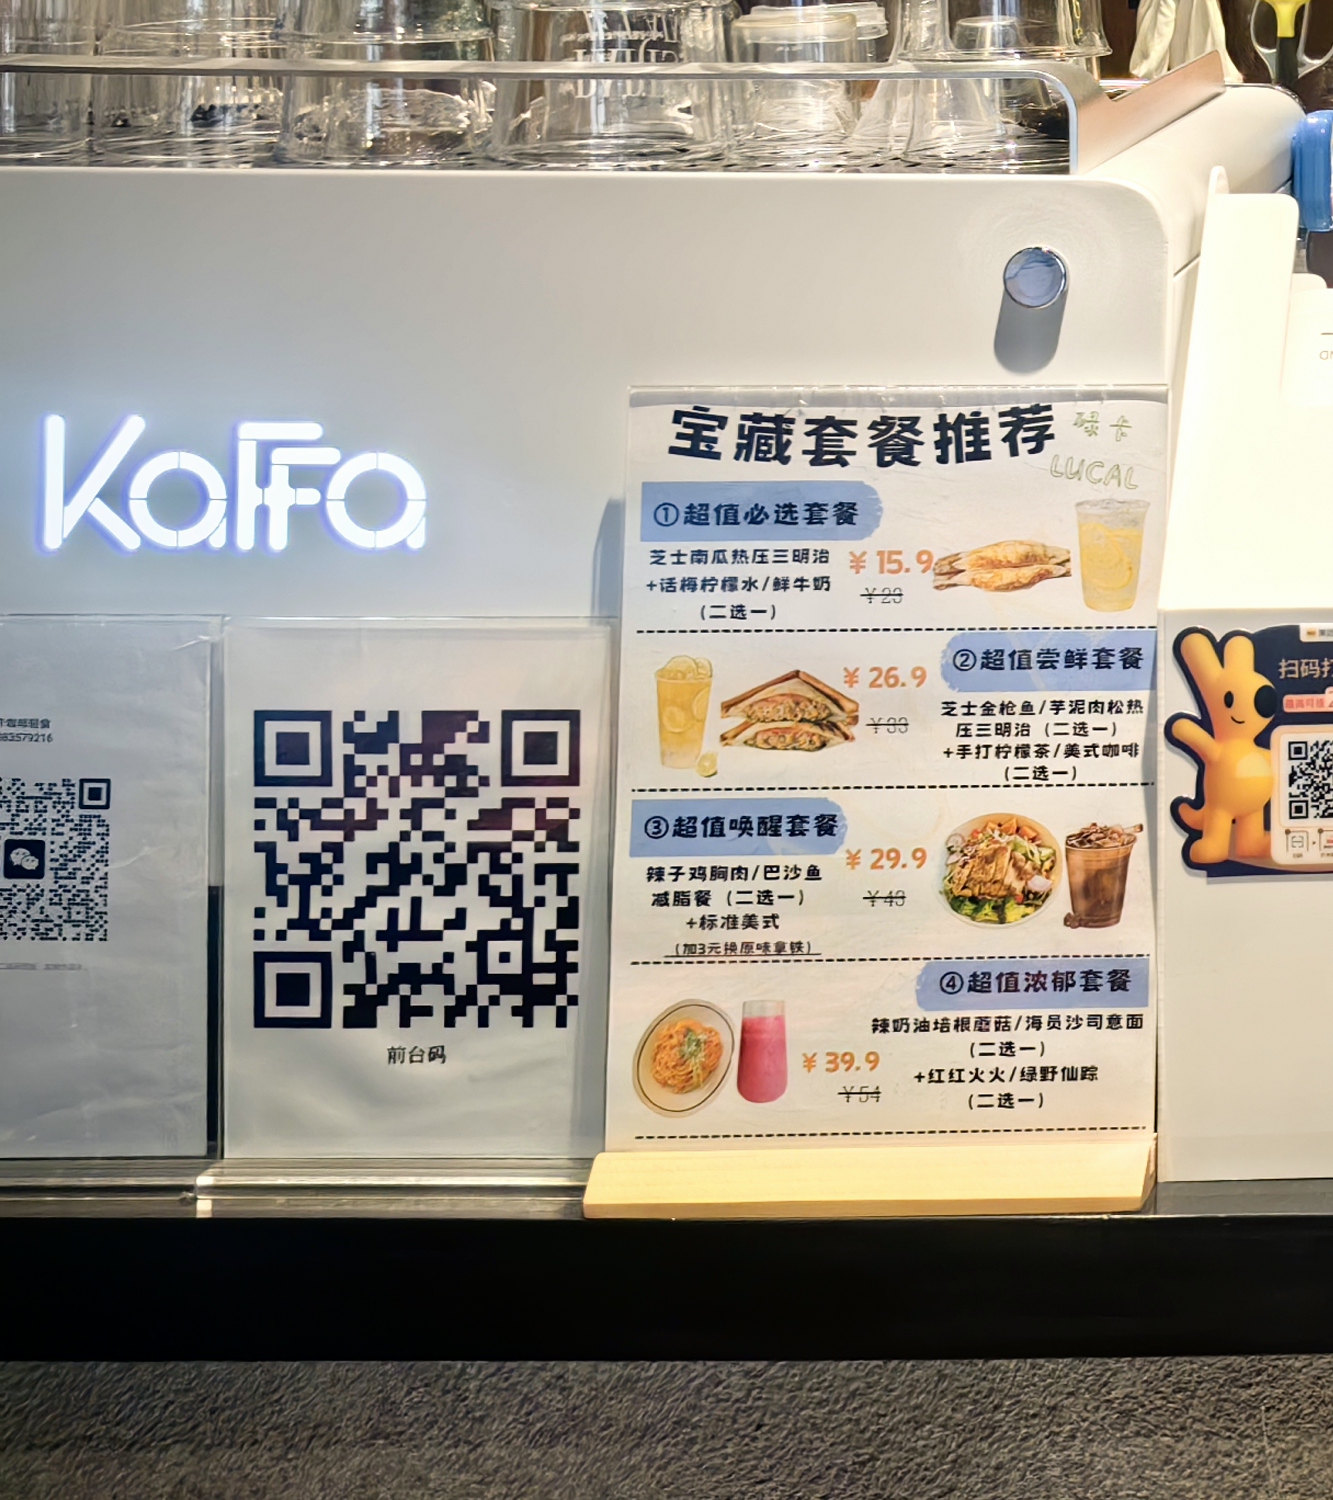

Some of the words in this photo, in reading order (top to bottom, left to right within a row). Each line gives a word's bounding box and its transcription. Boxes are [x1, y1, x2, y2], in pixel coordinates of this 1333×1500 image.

[668, 404, 1056, 467] 宝藏套餐推荐
[1050, 455, 1138, 490] LUCAL
[650, 548, 829, 565] 芝士南瓜热压三明治
[941, 699, 1143, 716] 芝士金枪鱼/芋泥肉松热
[943, 743, 1139, 759] +手打柠檬茶/美式咖啡
[647, 864, 822, 882] 辣子鸡胸肉/巴沙鱼
[686, 913, 779, 930] +标准美式
[871, 1014, 1143, 1034] 辣奶油培根蘑菇/海员沙司意面
[387, 1046, 447, 1066] 前台码
[914, 1066, 1098, 1083] +红红火火/绿野仙踪
